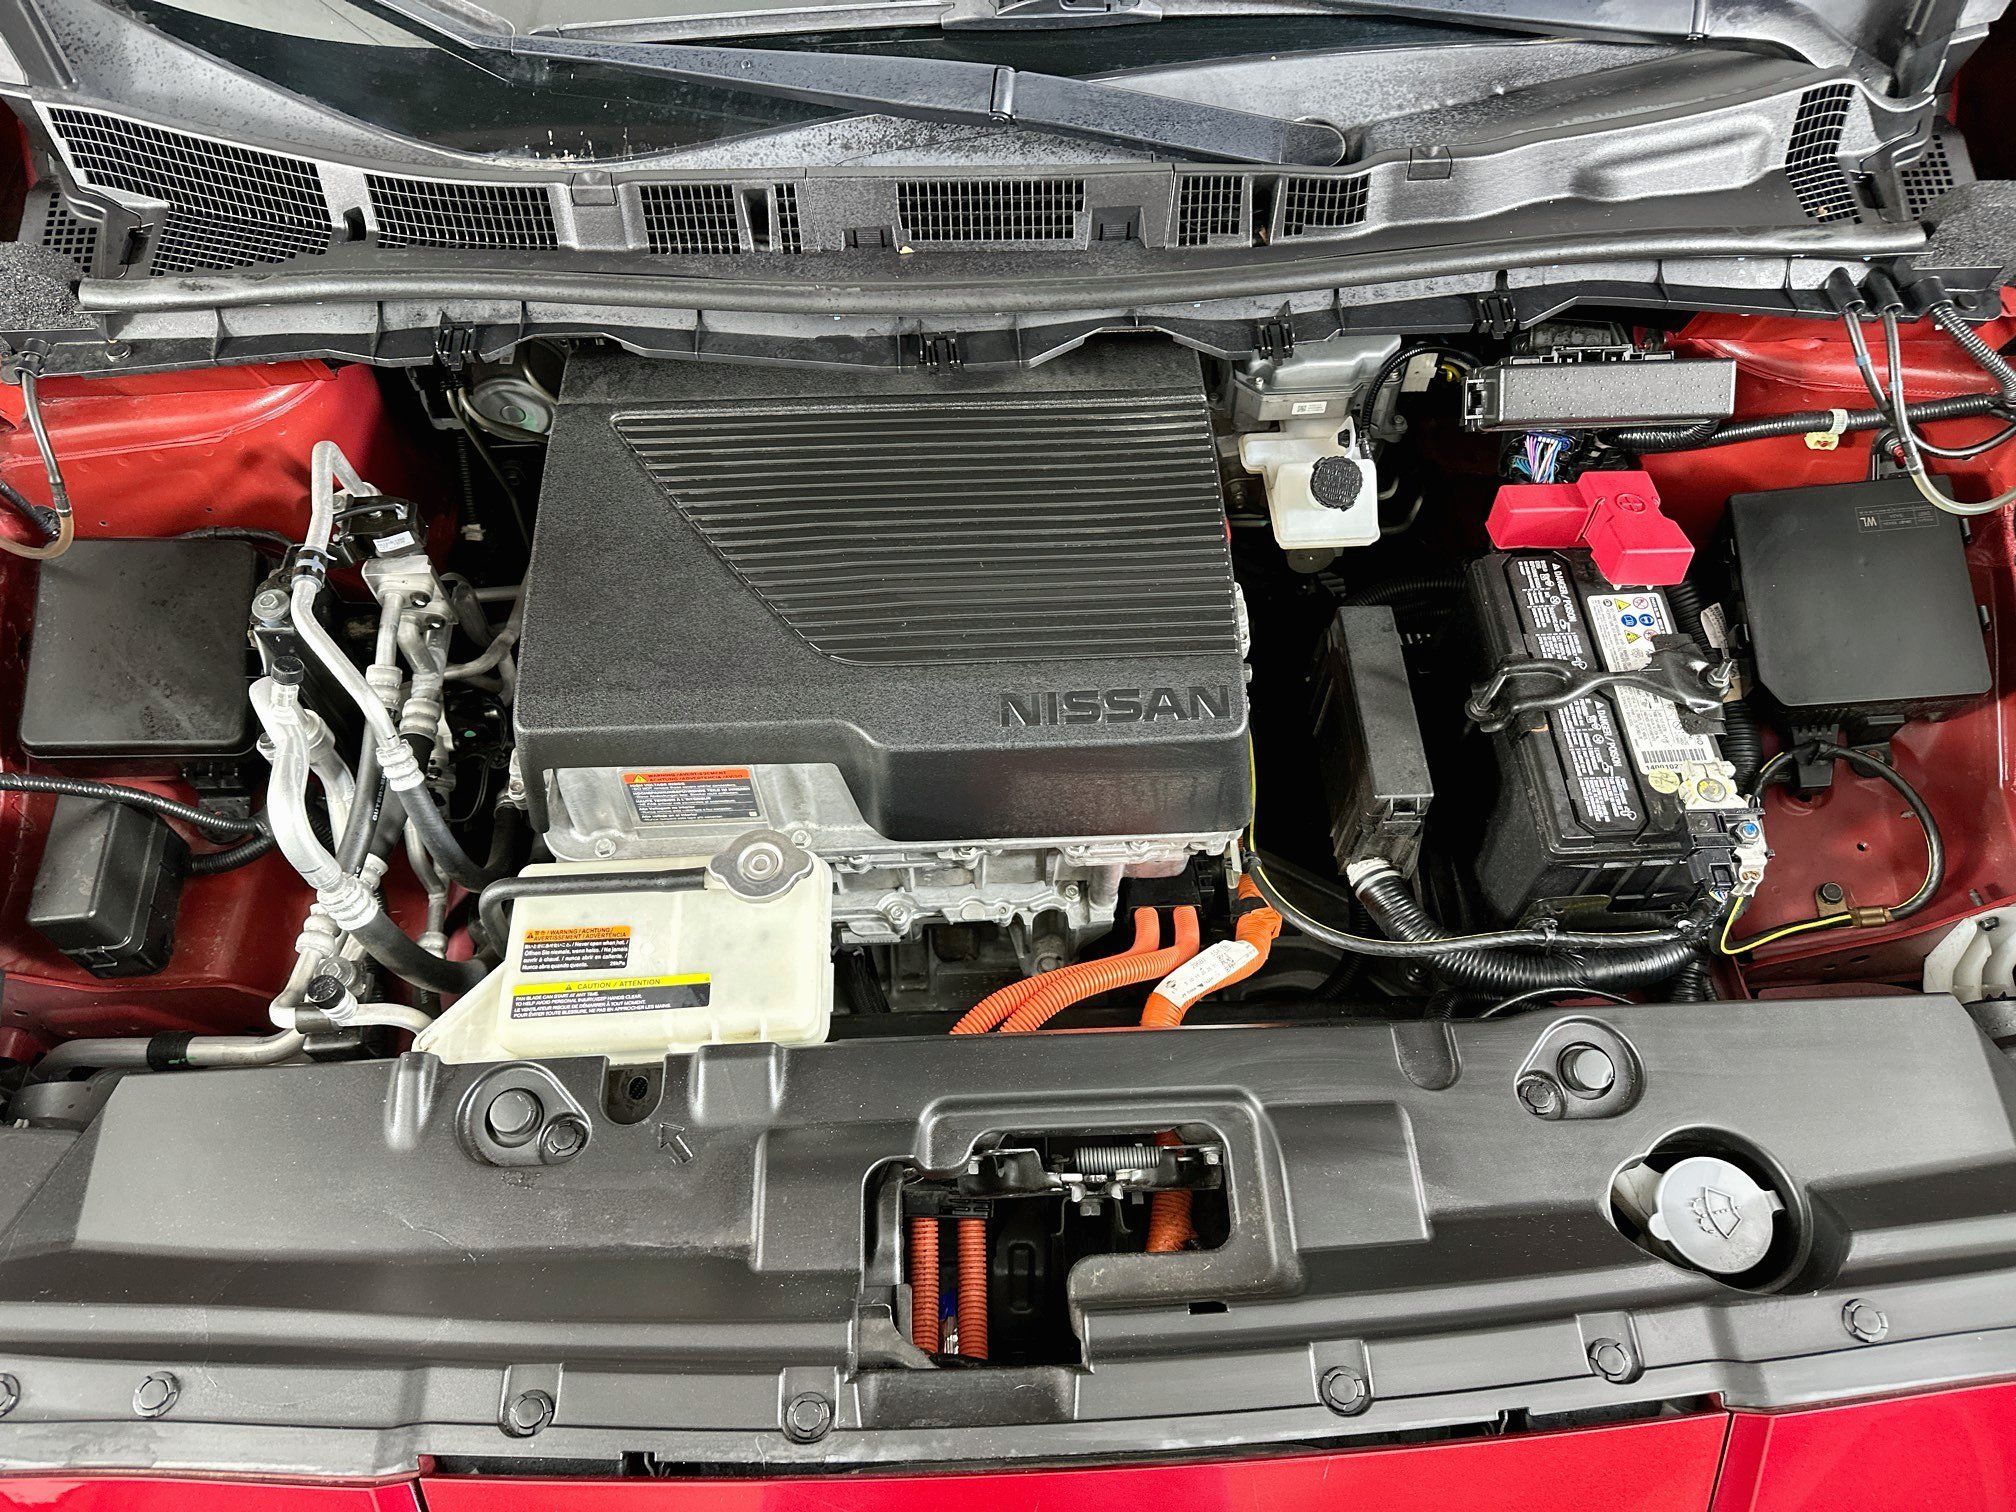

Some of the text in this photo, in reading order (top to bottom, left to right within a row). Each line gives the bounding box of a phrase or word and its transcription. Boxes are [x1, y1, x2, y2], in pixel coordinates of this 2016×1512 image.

[1563, 599, 1577, 622] POISON
[999, 684, 1231, 728] NISSAN
[1596, 709, 1613, 737] DANGER
[1606, 742, 1622, 767] POISON
[550, 928, 578, 936] WARNING
[577, 982, 611, 990] CAUTION
[619, 979, 661, 987] ATTENTION
